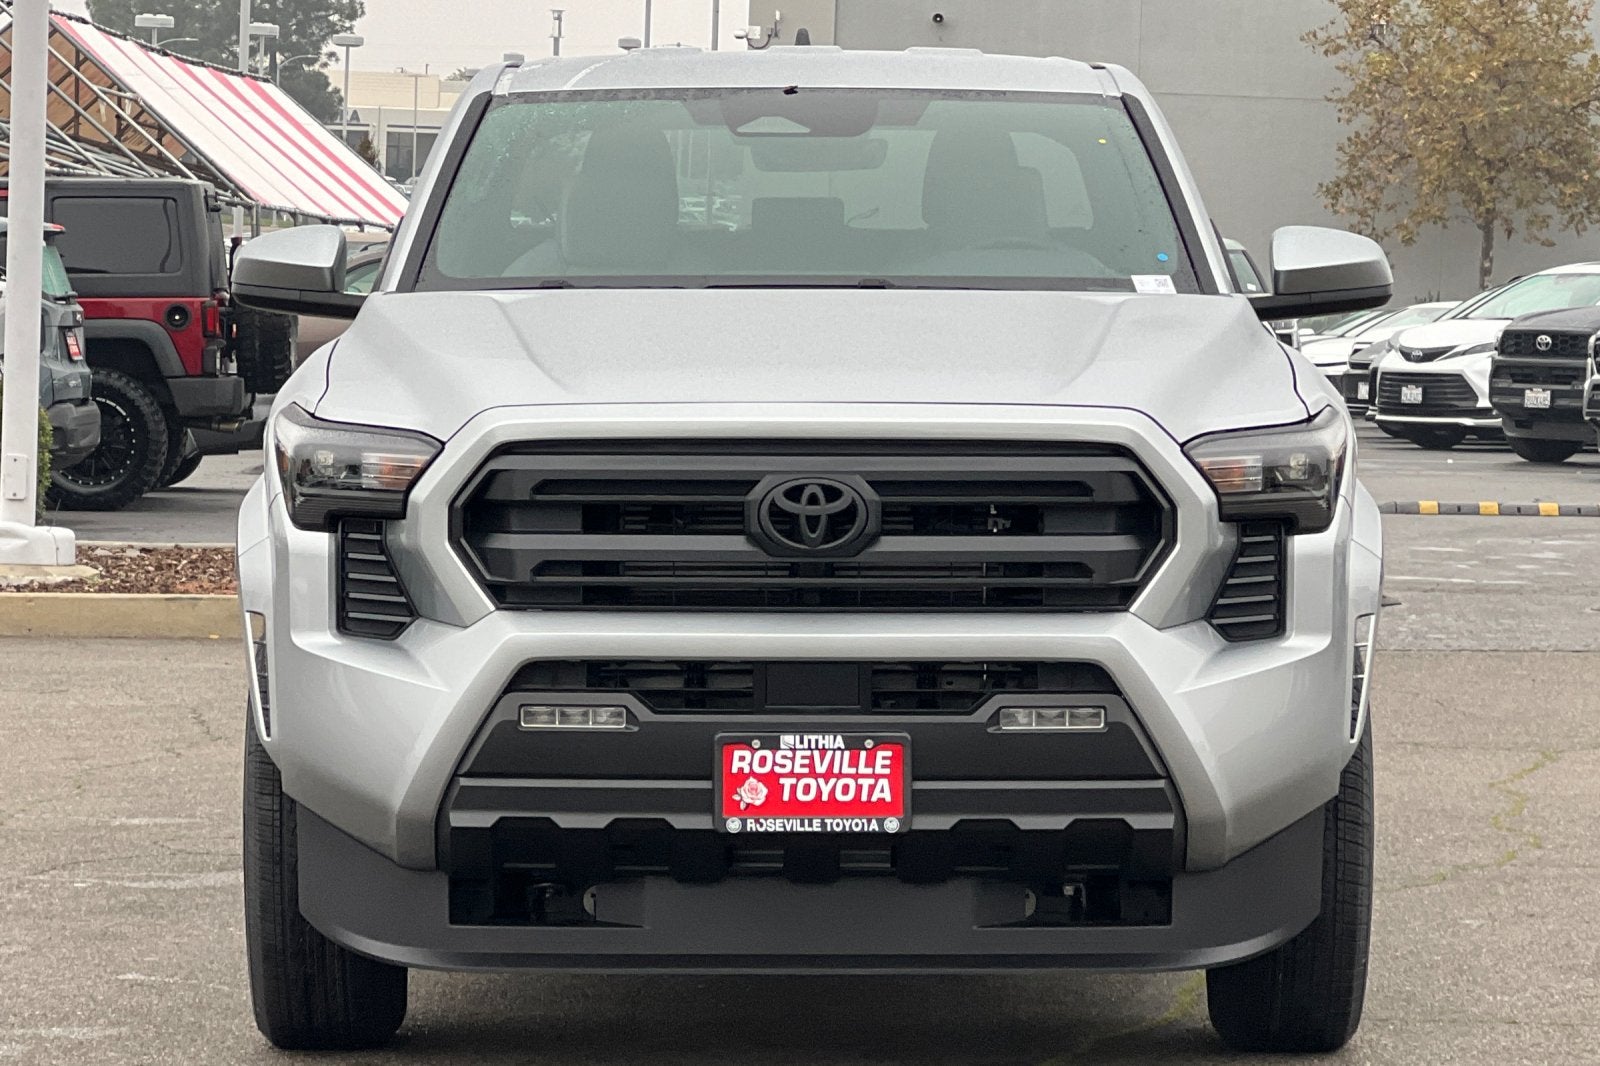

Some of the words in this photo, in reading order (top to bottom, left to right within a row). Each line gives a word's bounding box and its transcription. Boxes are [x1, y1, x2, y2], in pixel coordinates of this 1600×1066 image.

[795, 734, 845, 749] LITHIA
[731, 749, 893, 774] ROSEVILLE
[779, 777, 892, 803] TOYOTA
[746, 818, 822, 832] ROSEVILLE
[825, 818, 879, 832] TOYOTA
